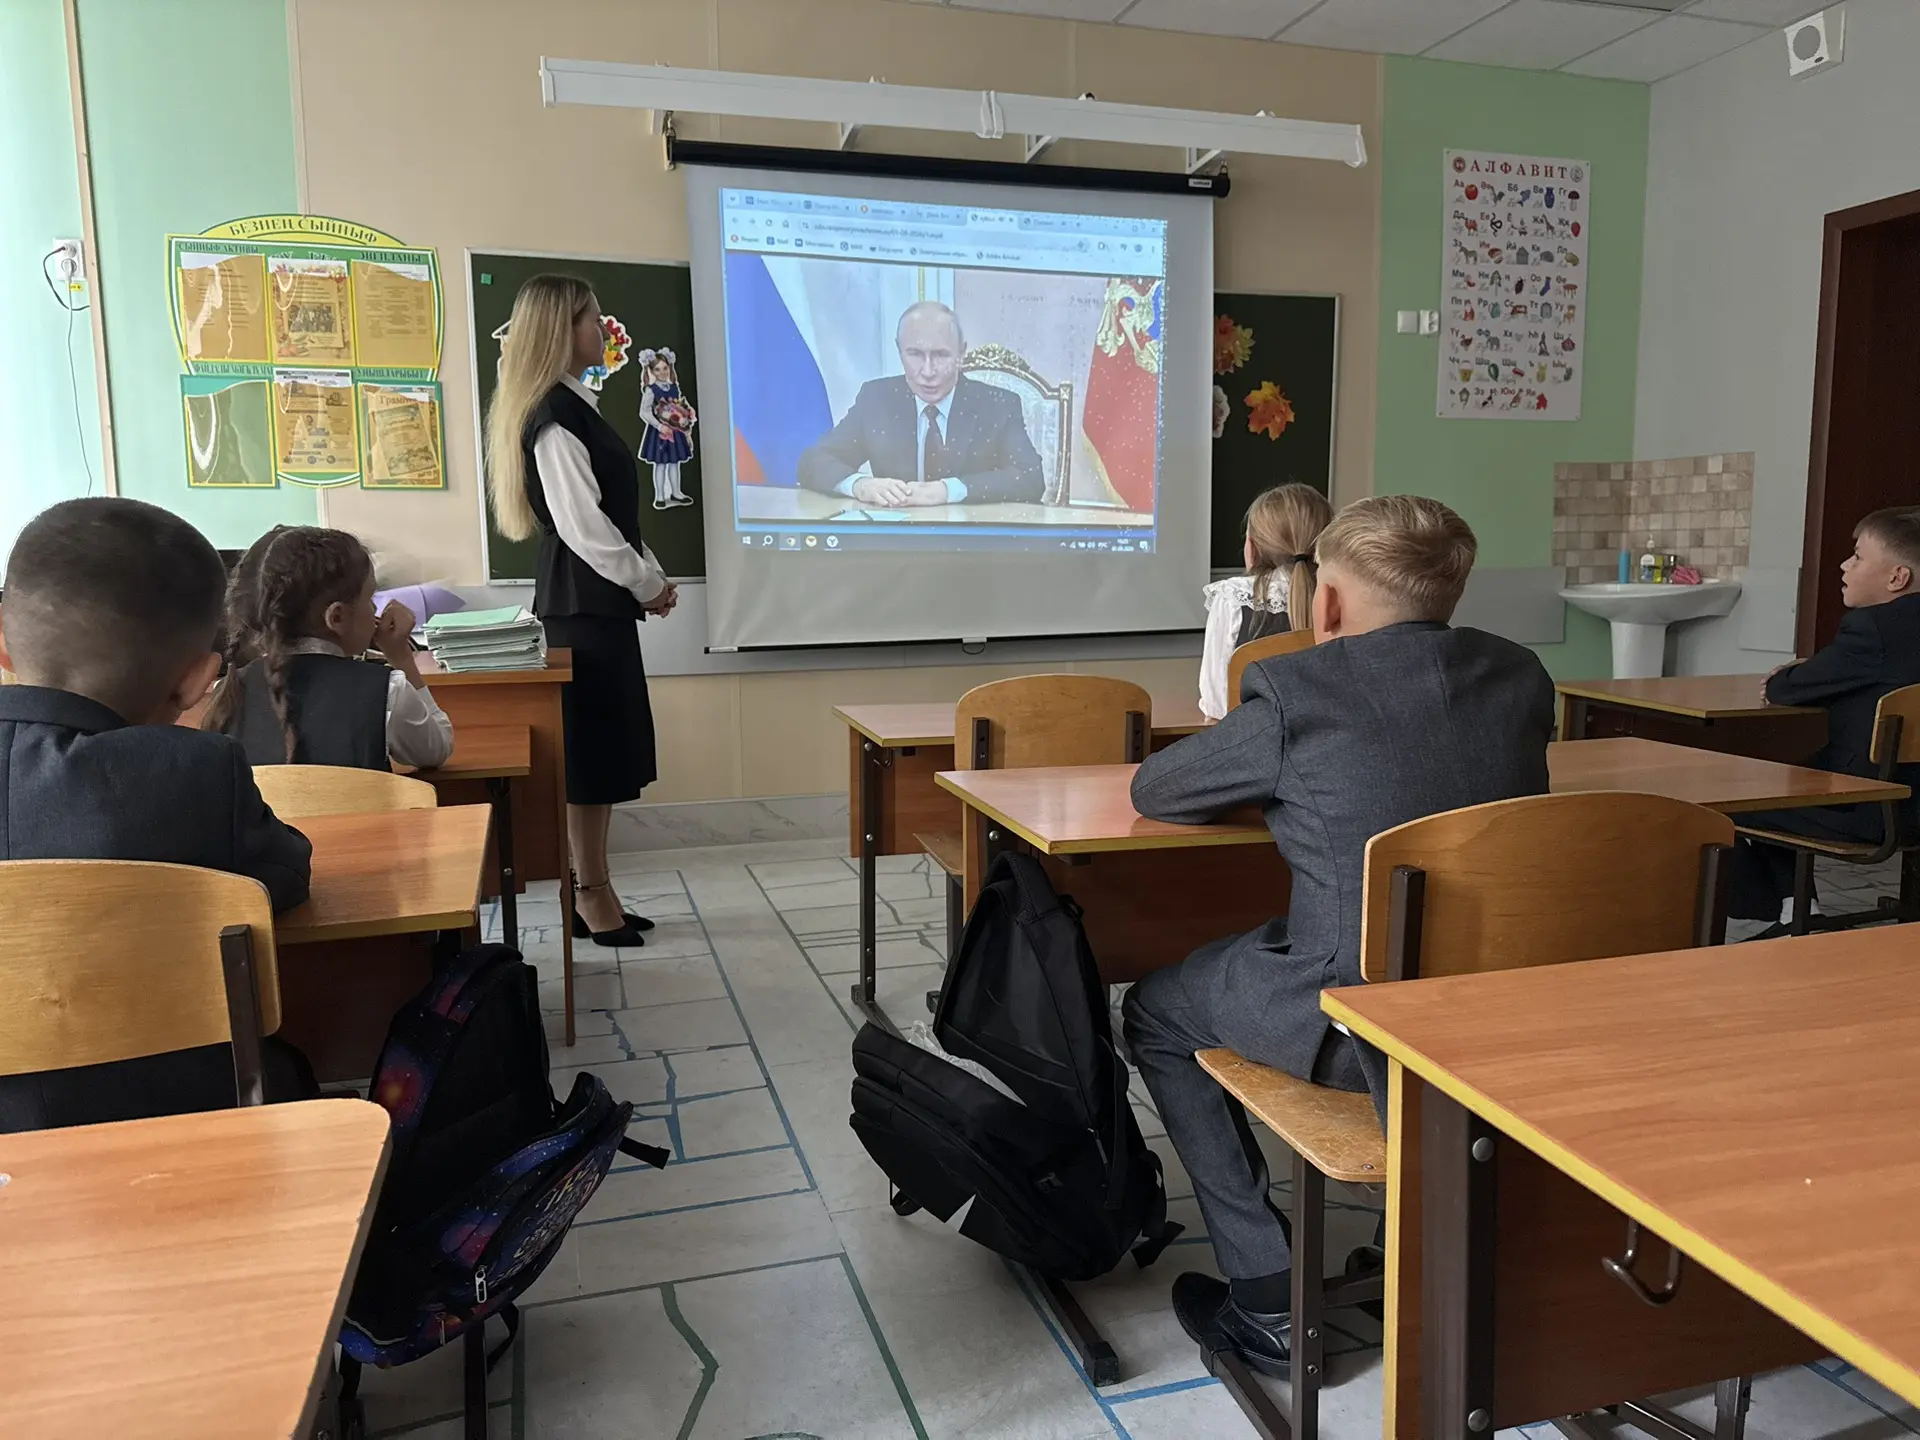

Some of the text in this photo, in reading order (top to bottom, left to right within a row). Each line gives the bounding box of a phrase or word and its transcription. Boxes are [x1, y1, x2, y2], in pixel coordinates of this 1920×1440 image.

[1470, 159, 1568, 179] АЛФАВИТ
[1508, 184, 1518, 192] Бб
[1533, 185, 1543, 194] Вв
[298, 218, 377, 242] СЫЙНЫФ
[1531, 274, 1542, 282] Оо
[1478, 298, 1488, 307] Рр
